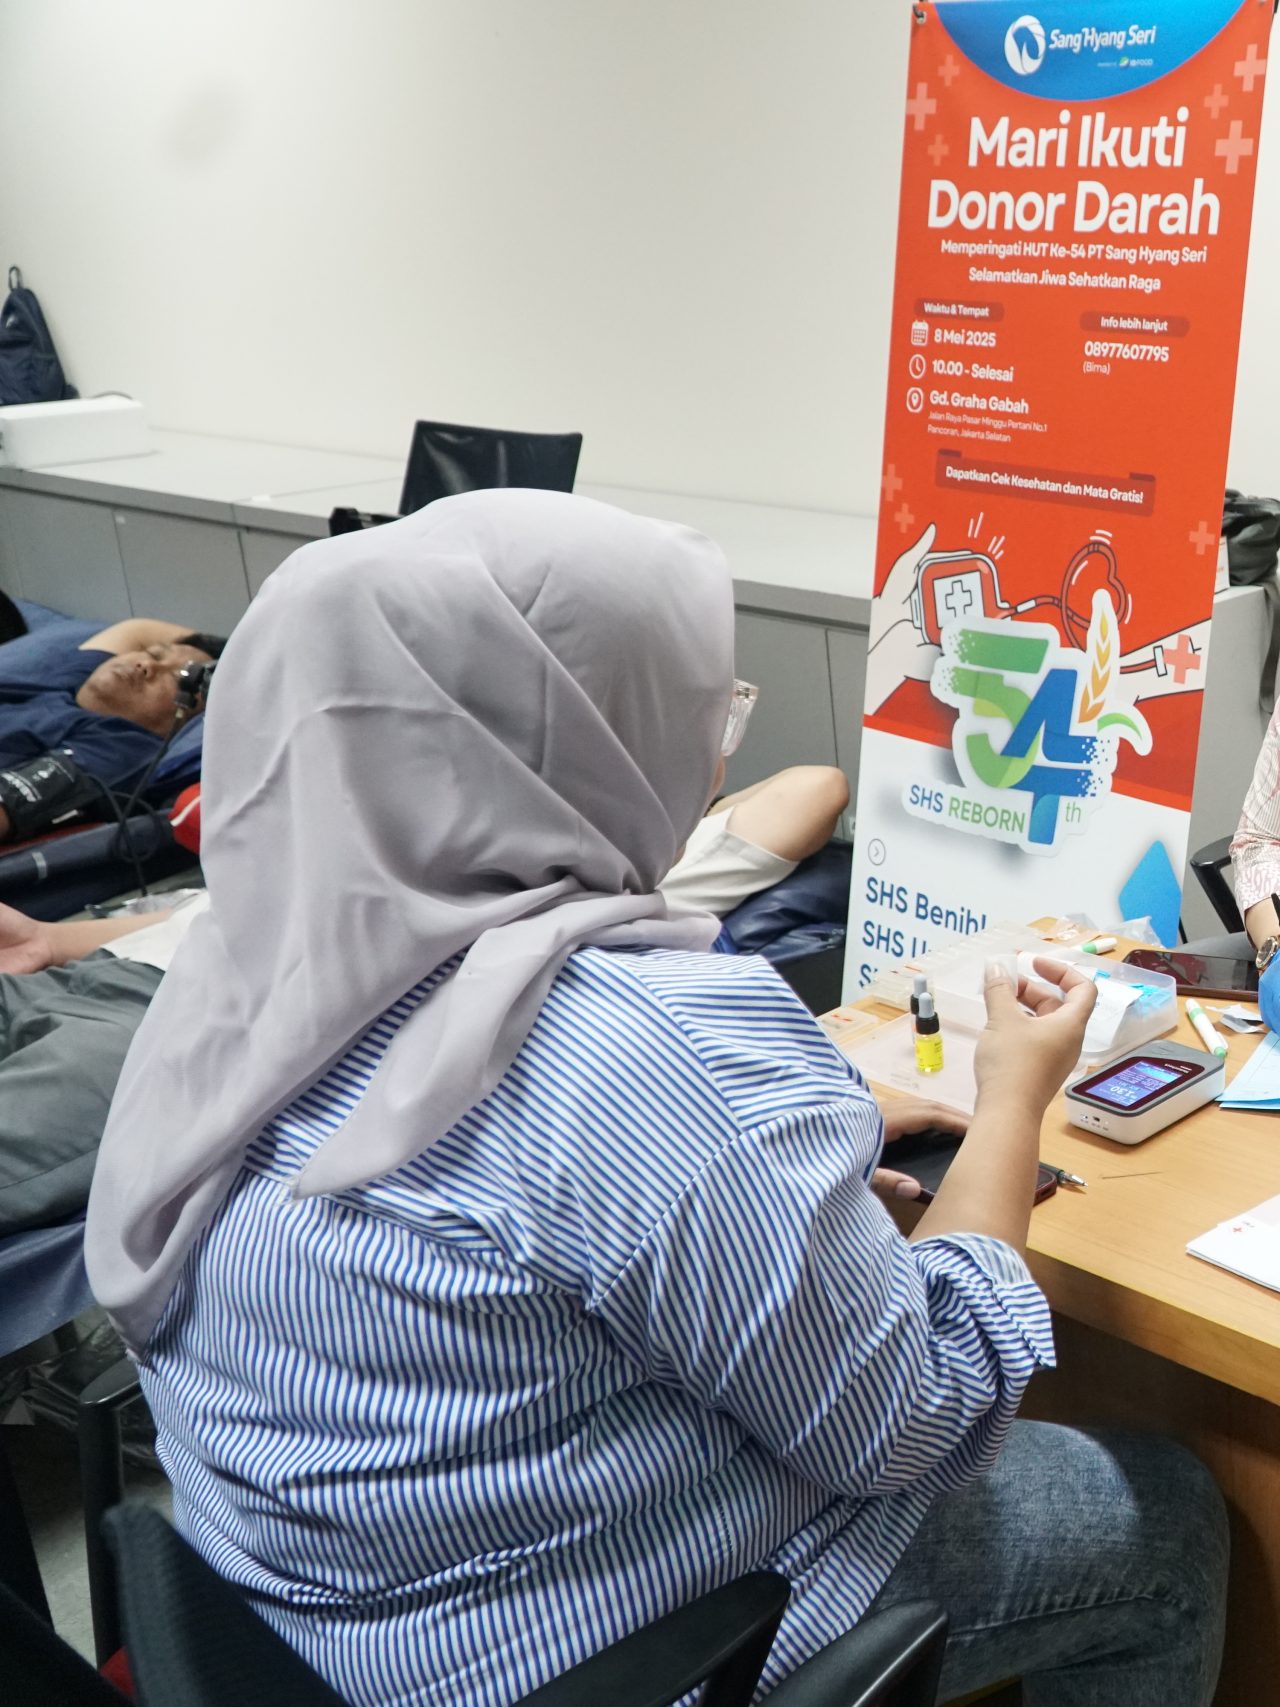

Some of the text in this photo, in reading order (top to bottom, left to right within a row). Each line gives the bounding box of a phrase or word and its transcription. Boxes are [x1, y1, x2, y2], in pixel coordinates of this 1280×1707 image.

[1048, 24, 1157, 53] Sang Hyang Seri
[968, 105, 1190, 168] Mari Ikuti
[927, 177, 1221, 236] Donor Darah
[940, 239, 1207, 265] Memperingati HUT Ke-54 PT Sang Hyang Seri
[968, 267, 1161, 293] Selamatkan Jiwa Sehatkan Raga
[924, 302, 990, 319] Waktu & Tempat
[934, 328, 996, 347] 8 Mei 2025
[1100, 316, 1168, 334] Info lebih lanjut
[1084, 340, 1169, 362] 08977607795
[932, 359, 963, 377] 10.00
[971, 363, 1014, 382] Selesai
[1083, 360, 1111, 375] (Bima)
[930, 389, 1030, 414] Gd. Graha Gabah
[946, 466, 1144, 504] Dapatkan Cek Kesehatan dan Mata Gratis!
[909, 784, 1026, 834] SHS REBORN
[1065, 801, 1082, 824] th
[865, 876, 908, 914] SHS
[862, 920, 904, 958] SHS
